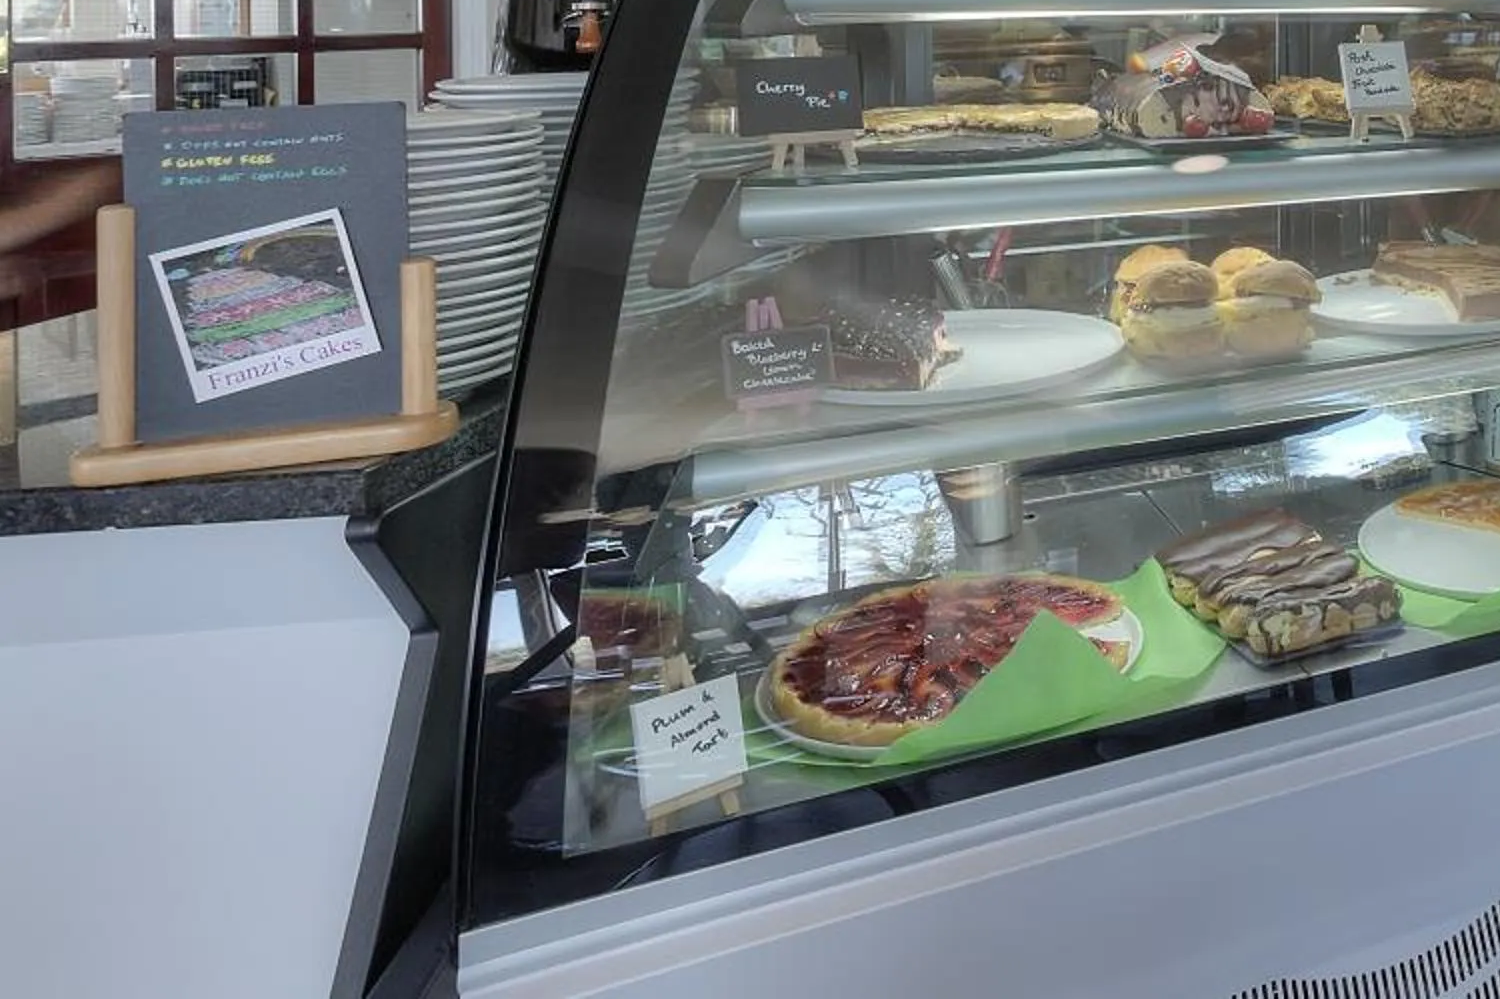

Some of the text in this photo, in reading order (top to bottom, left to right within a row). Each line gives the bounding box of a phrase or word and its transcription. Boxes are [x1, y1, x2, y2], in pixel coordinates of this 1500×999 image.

[756, 80, 805, 96] Cherry
[806, 96, 830, 108] Pie
[176, 154, 275, 169] GLUTEN FREE
[208, 338, 363, 390] Franzi's Cakes
[651, 704, 695, 733] Plum
[671, 710, 721, 748] Almond
